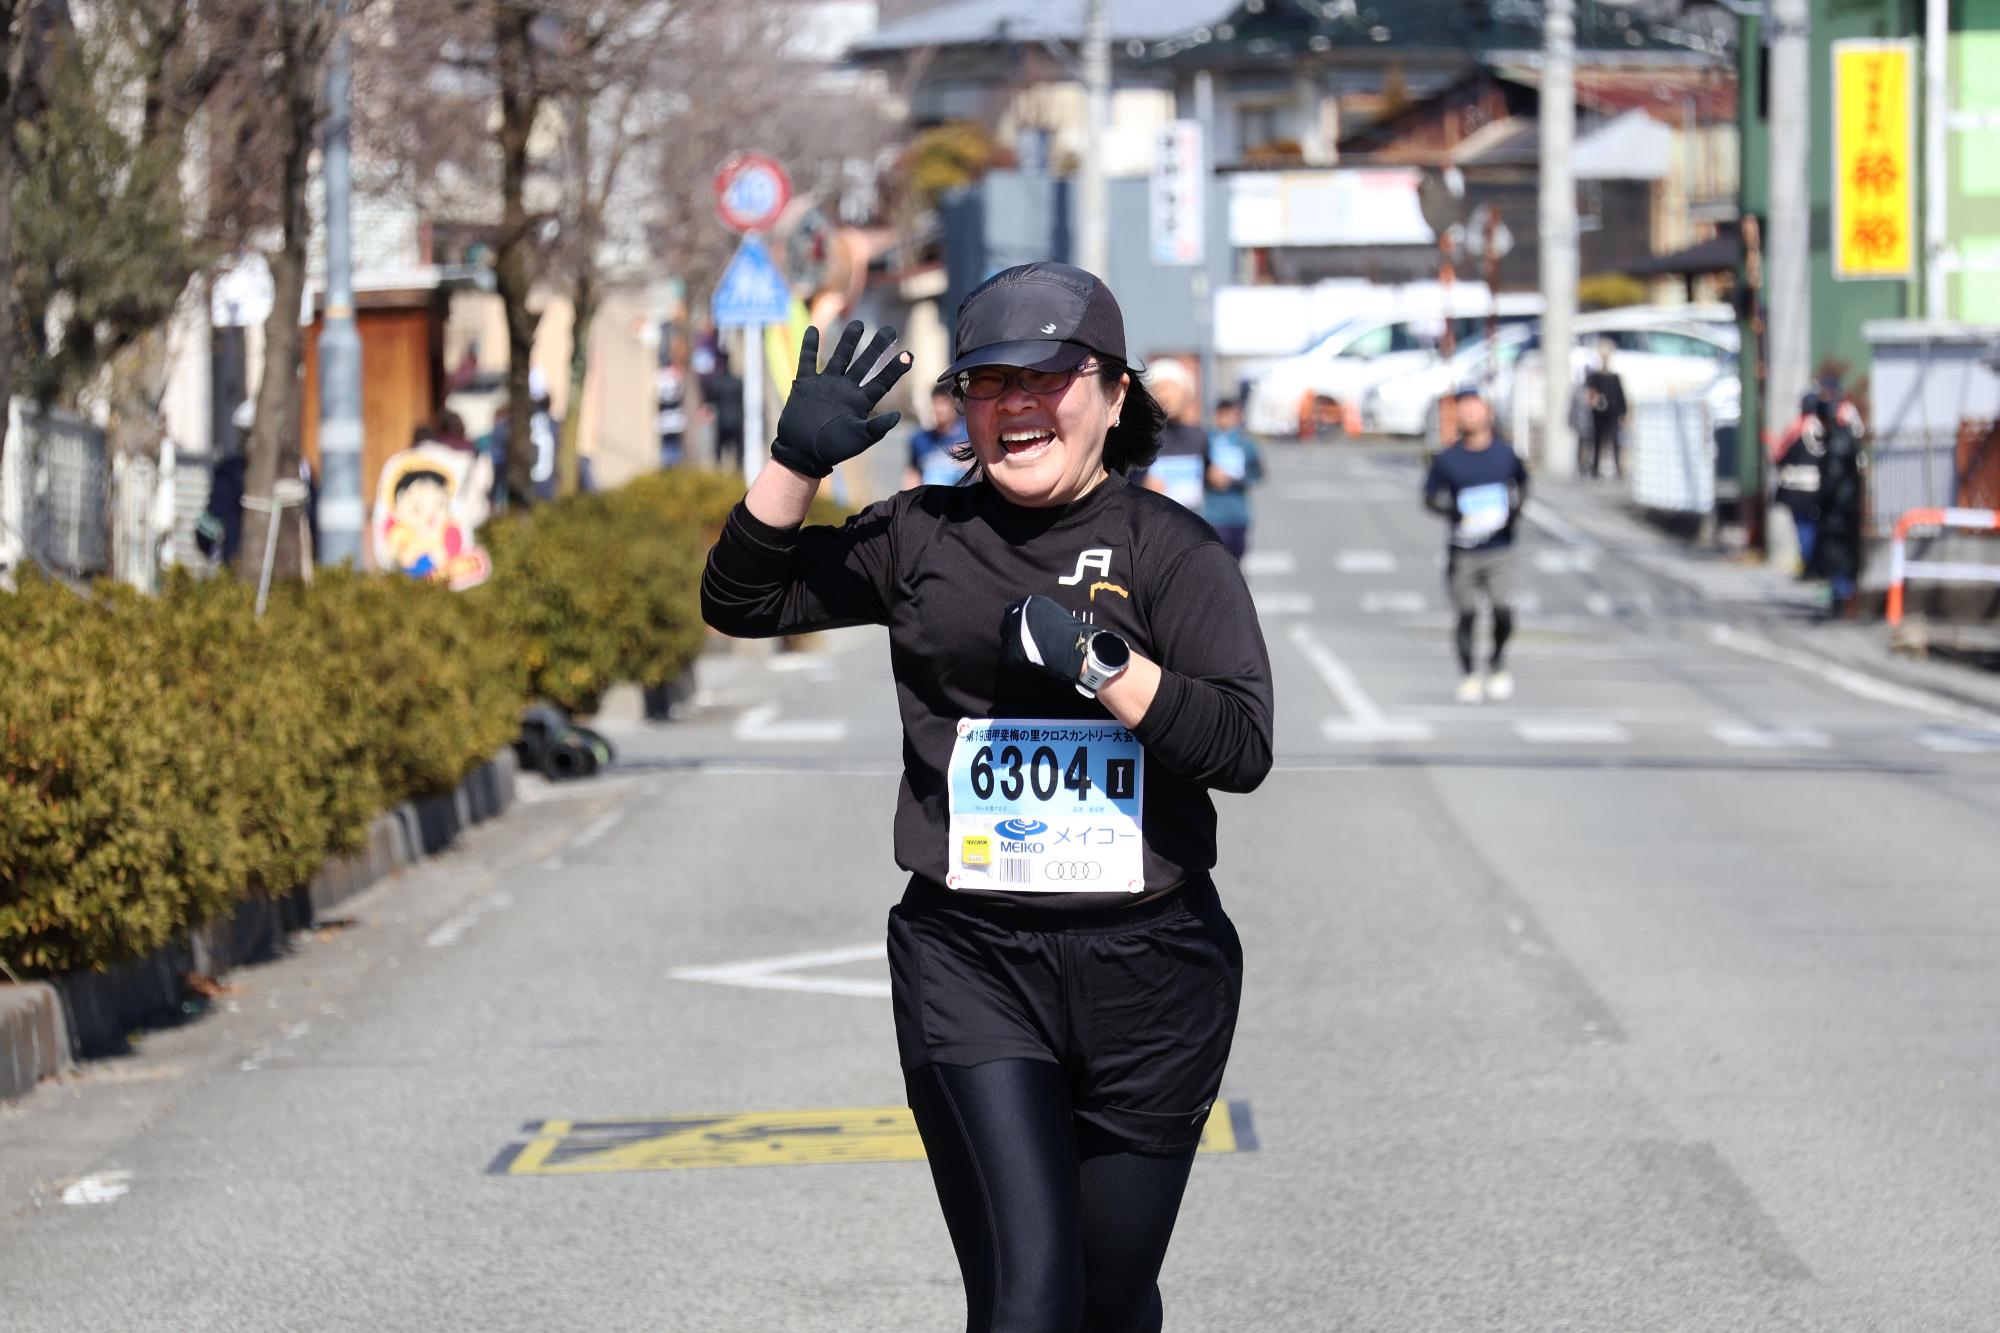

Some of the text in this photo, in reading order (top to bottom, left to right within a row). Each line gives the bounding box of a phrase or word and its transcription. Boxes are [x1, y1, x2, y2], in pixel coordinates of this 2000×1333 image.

[971, 745, 1092, 801] 6304
[1054, 827, 1136, 845] メイコー
[1000, 841, 1044, 854] MEIKO
